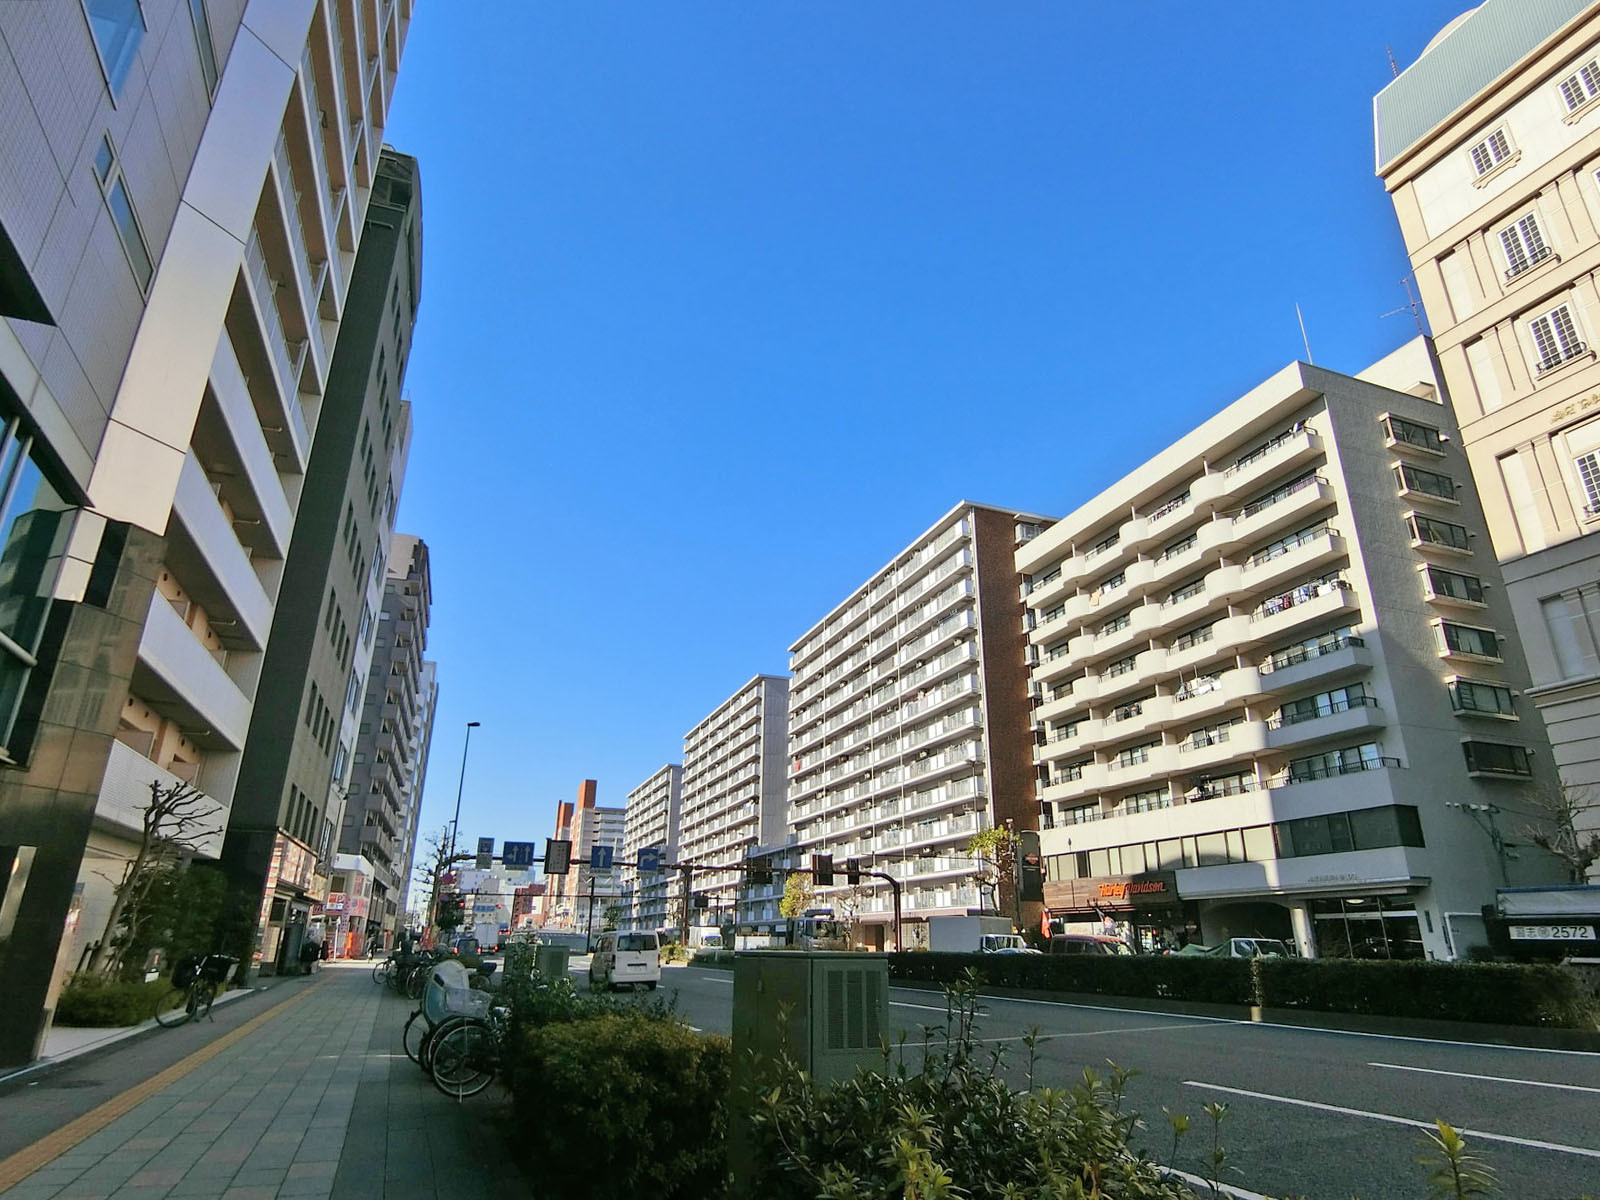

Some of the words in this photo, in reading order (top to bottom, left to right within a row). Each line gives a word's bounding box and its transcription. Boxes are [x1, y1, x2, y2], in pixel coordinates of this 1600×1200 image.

[1098, 882, 1127, 900] Harley
[1126, 881, 1167, 894] Davidson
[1551, 926, 1589, 938] 2572
